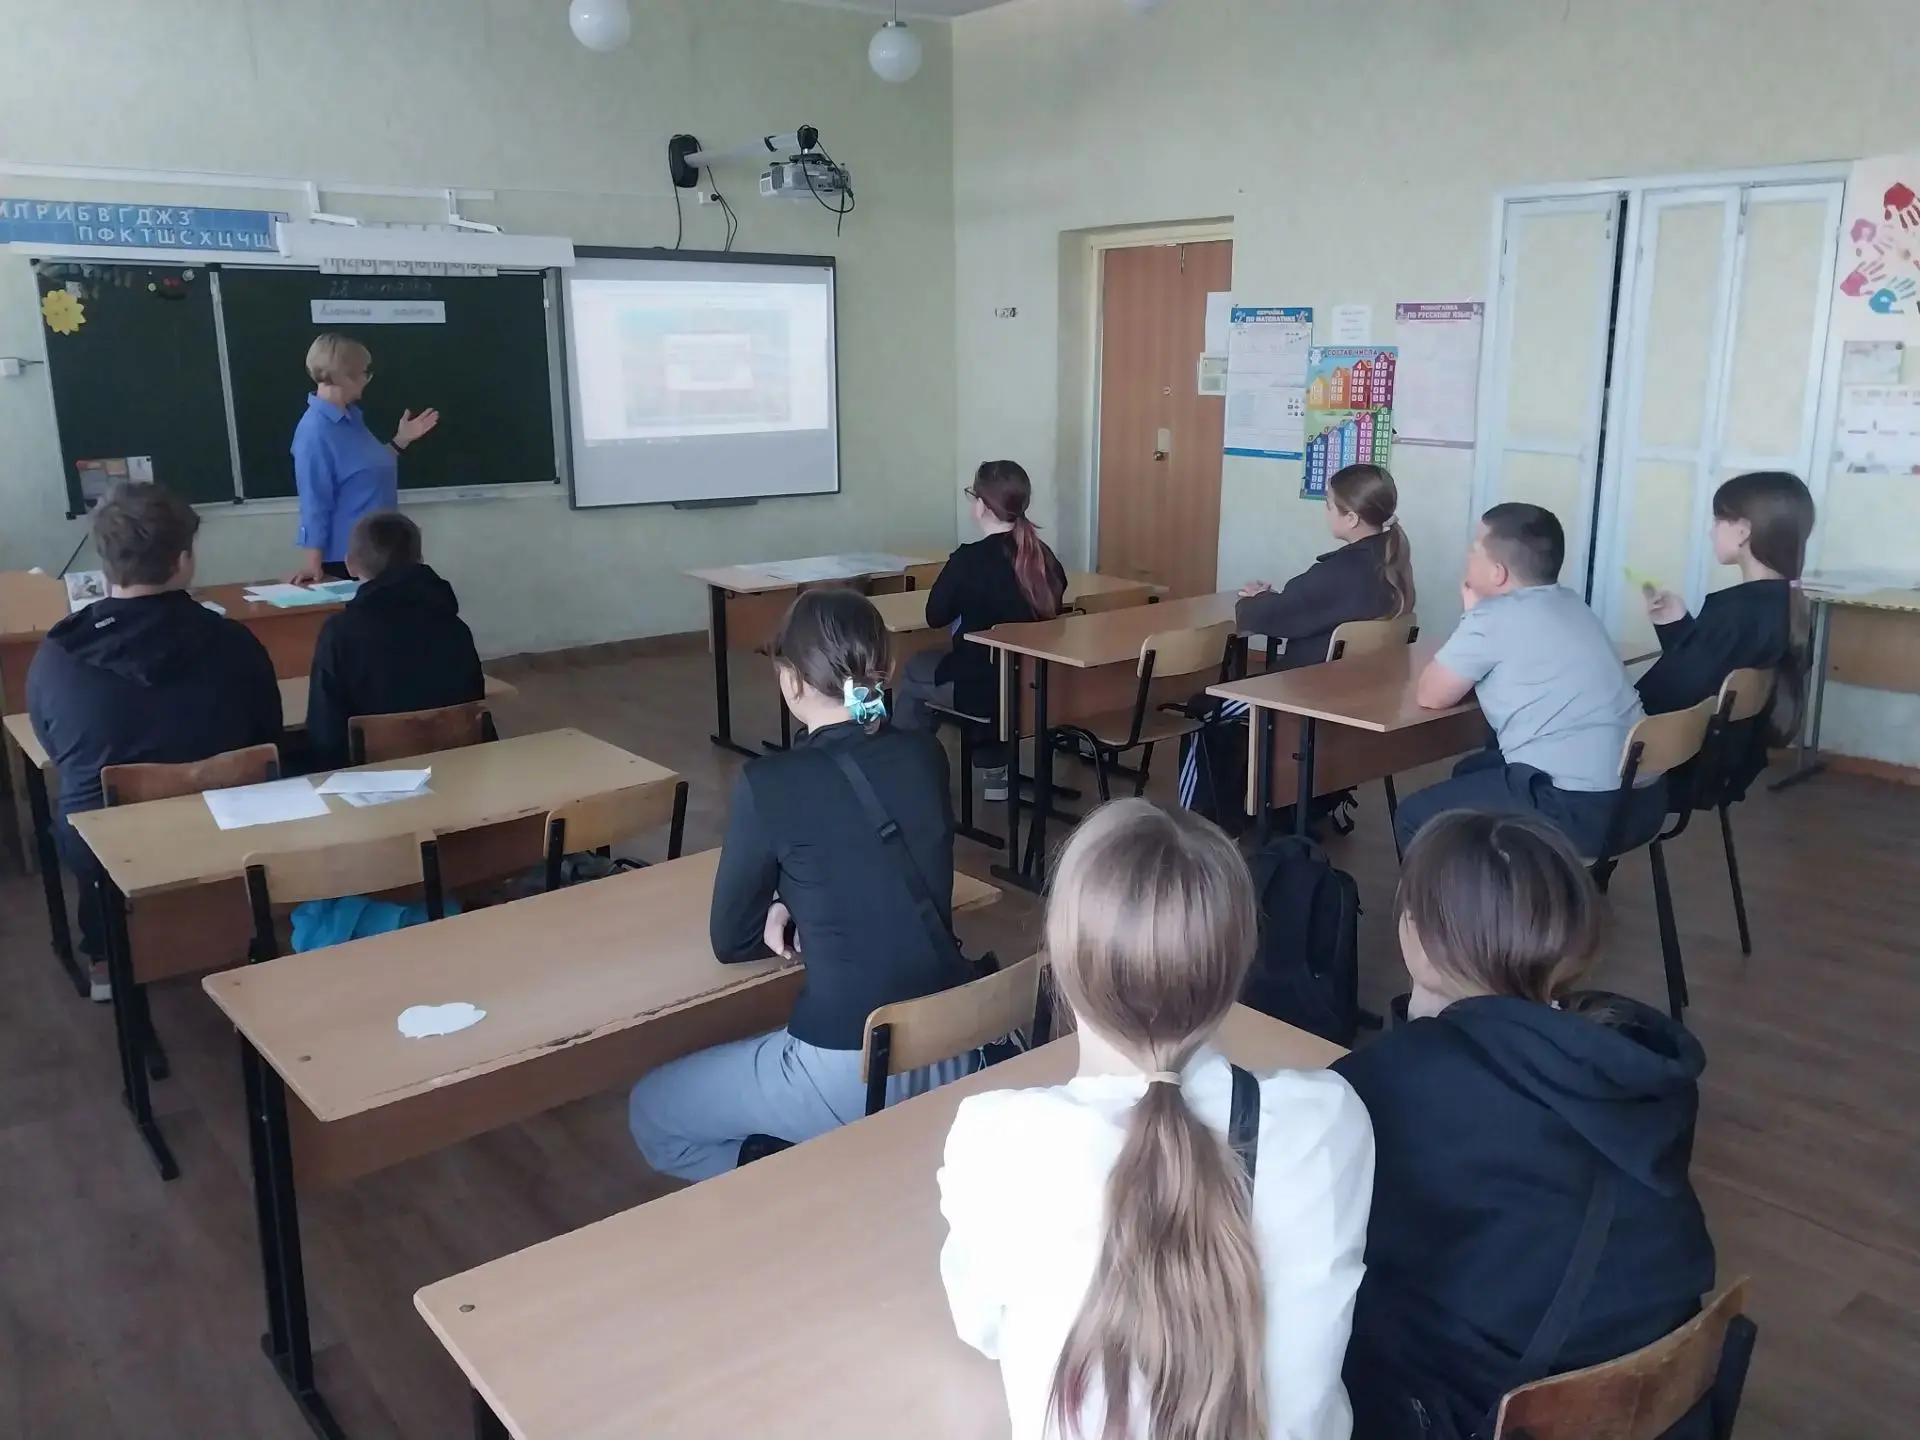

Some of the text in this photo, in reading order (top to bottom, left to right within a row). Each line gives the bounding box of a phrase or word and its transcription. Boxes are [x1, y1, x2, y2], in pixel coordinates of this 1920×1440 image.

[78, 206, 89, 220] Б
[98, 207, 110, 222] В
[118, 208, 131, 223] Г
[136, 209, 152, 225] Д
[156, 210, 173, 225] Ж
[178, 211, 190, 226] З
[79, 226, 92, 241] П
[98, 228, 114, 242] Ф
[120, 228, 132, 242] К
[200, 232, 212, 245] Х
[237, 232, 249, 247] Ч
